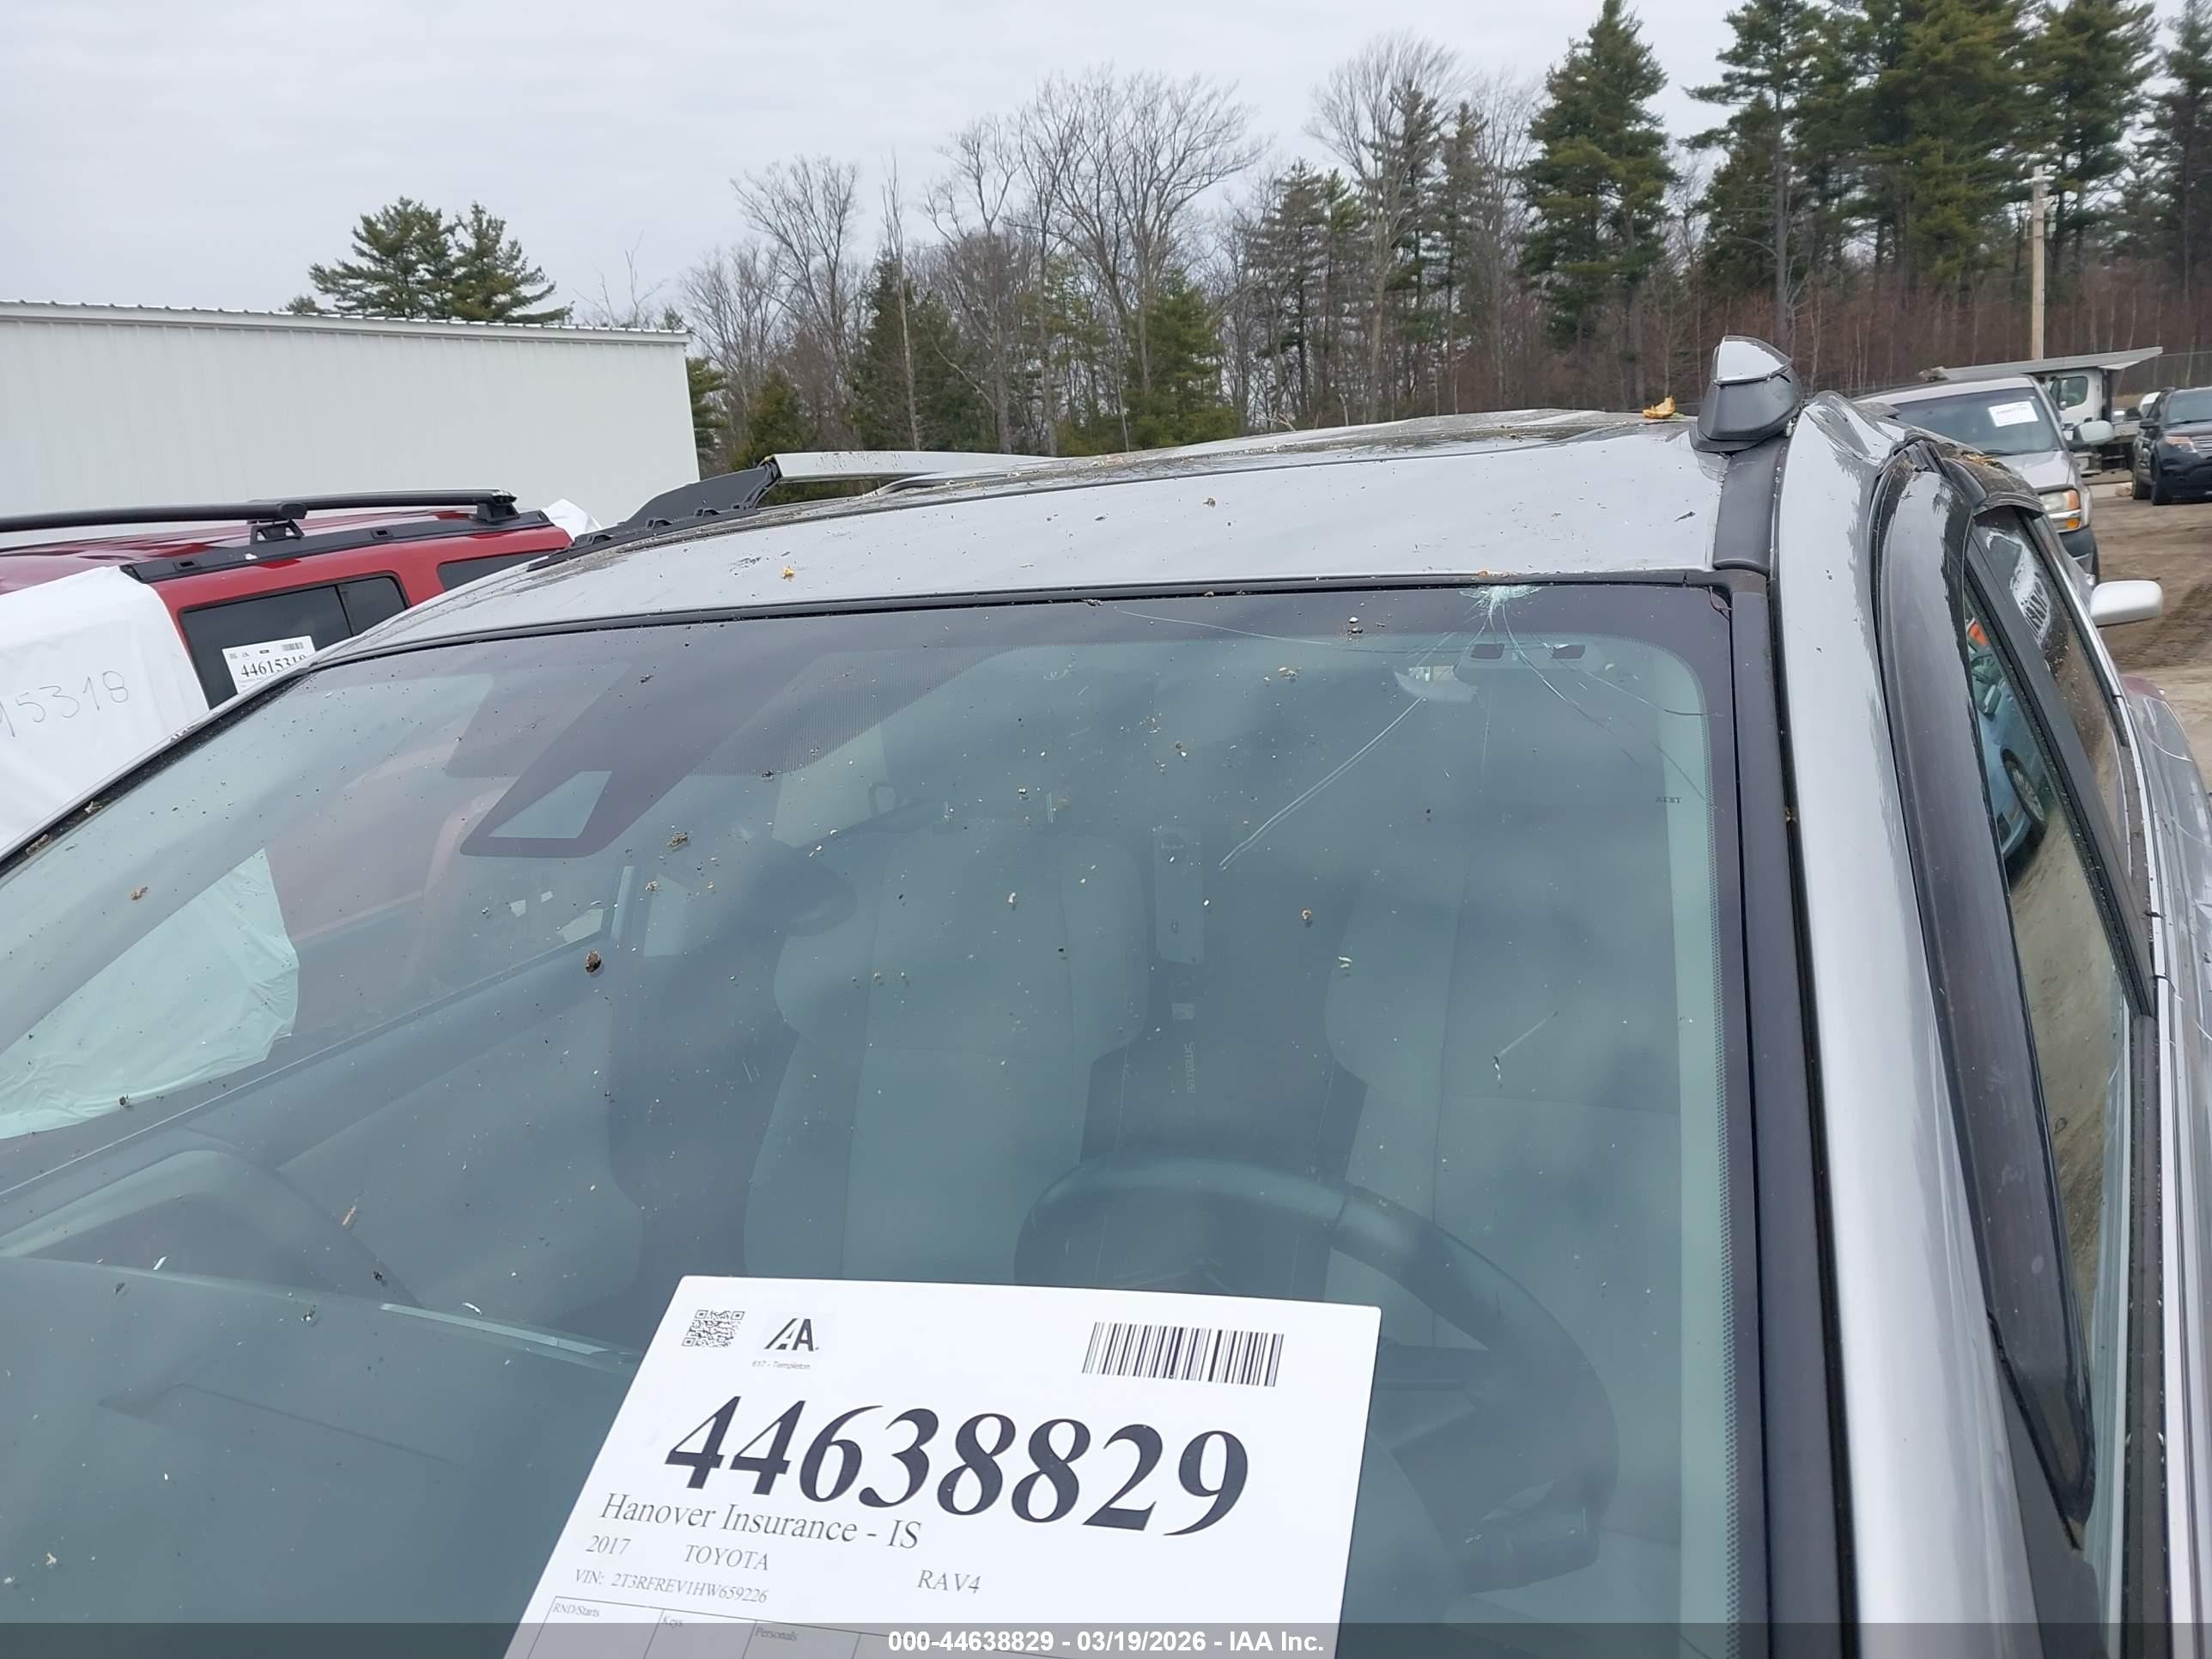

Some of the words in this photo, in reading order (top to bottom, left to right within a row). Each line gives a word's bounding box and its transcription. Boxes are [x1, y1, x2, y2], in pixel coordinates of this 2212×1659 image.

[664, 1395, 1248, 1536] 44638829
[599, 1492, 716, 1528] Hanover
[720, 1504, 857, 1541] Insurance
[886, 1520, 921, 1548] IS
[586, 1535, 631, 1555] 2017
[684, 1544, 769, 1571] TOYOTA
[917, 1569, 982, 1593] RAV4
[575, 1568, 605, 1585] VIN:
[552, 1602, 600, 1617] RND/Starts
[661, 1615, 684, 1628] Keys
[755, 1626, 798, 1641] Personals
